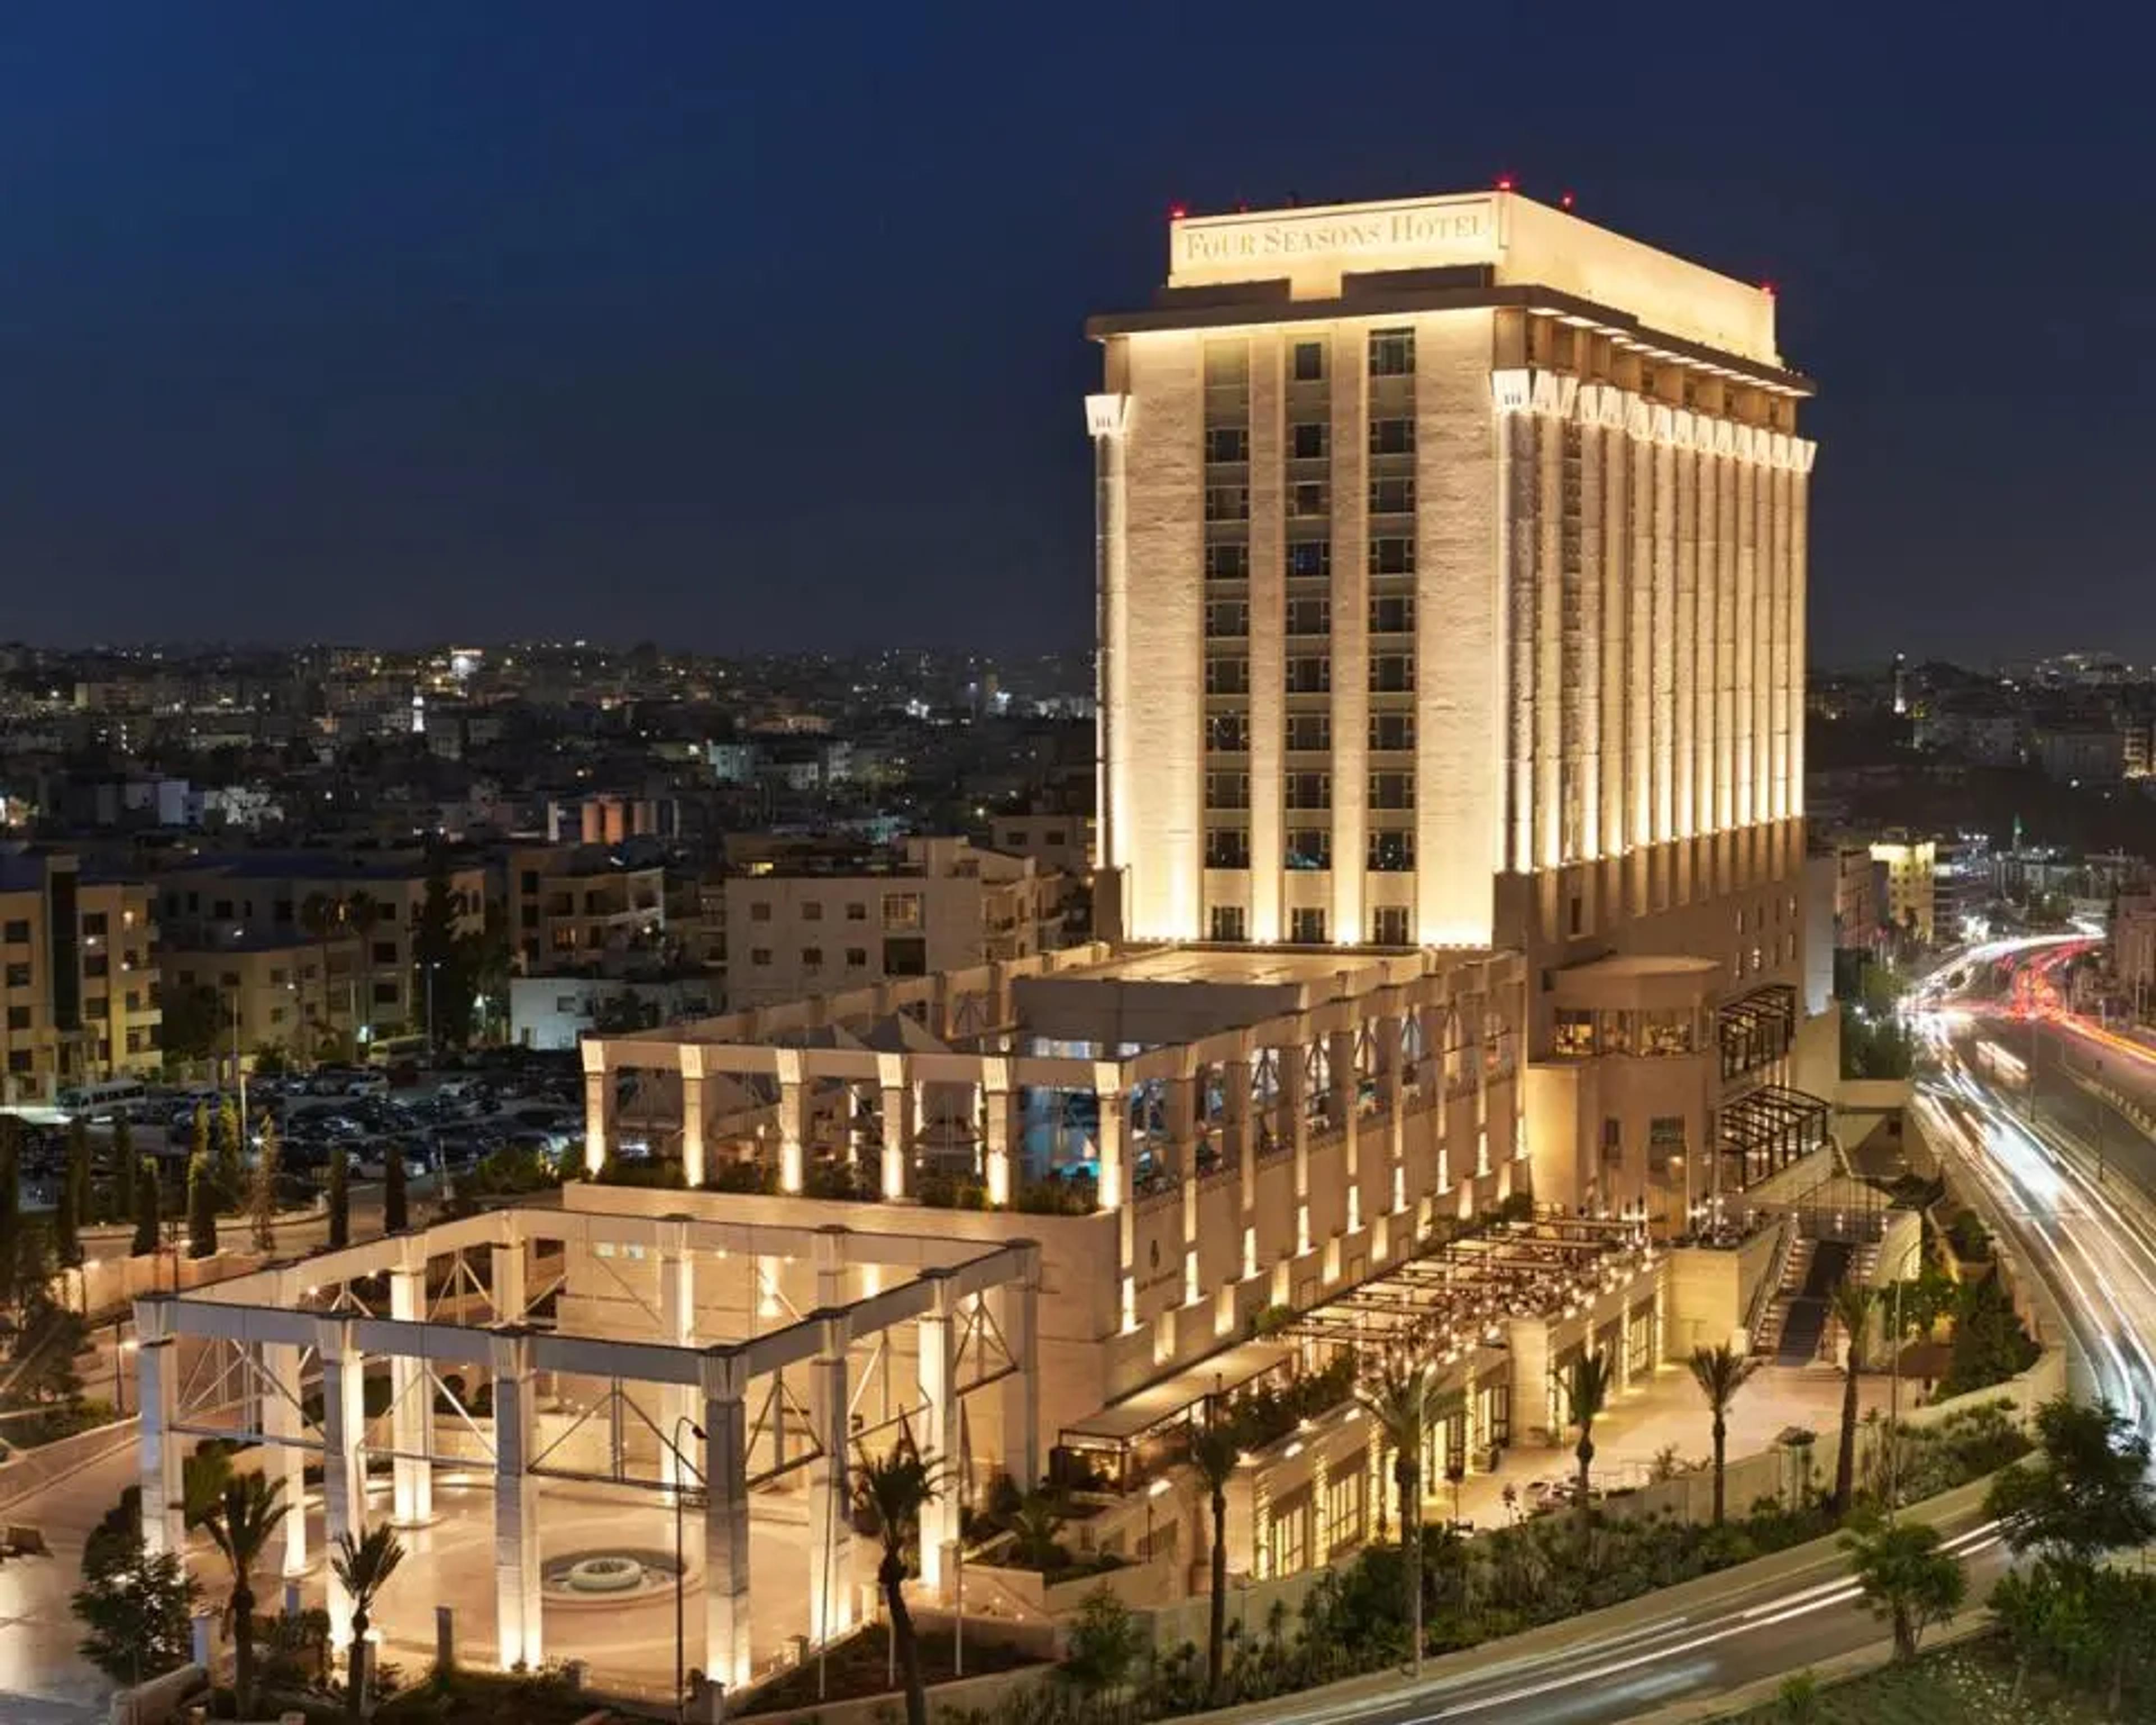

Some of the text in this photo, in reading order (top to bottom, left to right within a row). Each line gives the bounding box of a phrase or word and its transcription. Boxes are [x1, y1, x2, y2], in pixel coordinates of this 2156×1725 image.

[1186, 215, 1487, 260] FOUR SEASONS HOTEL
